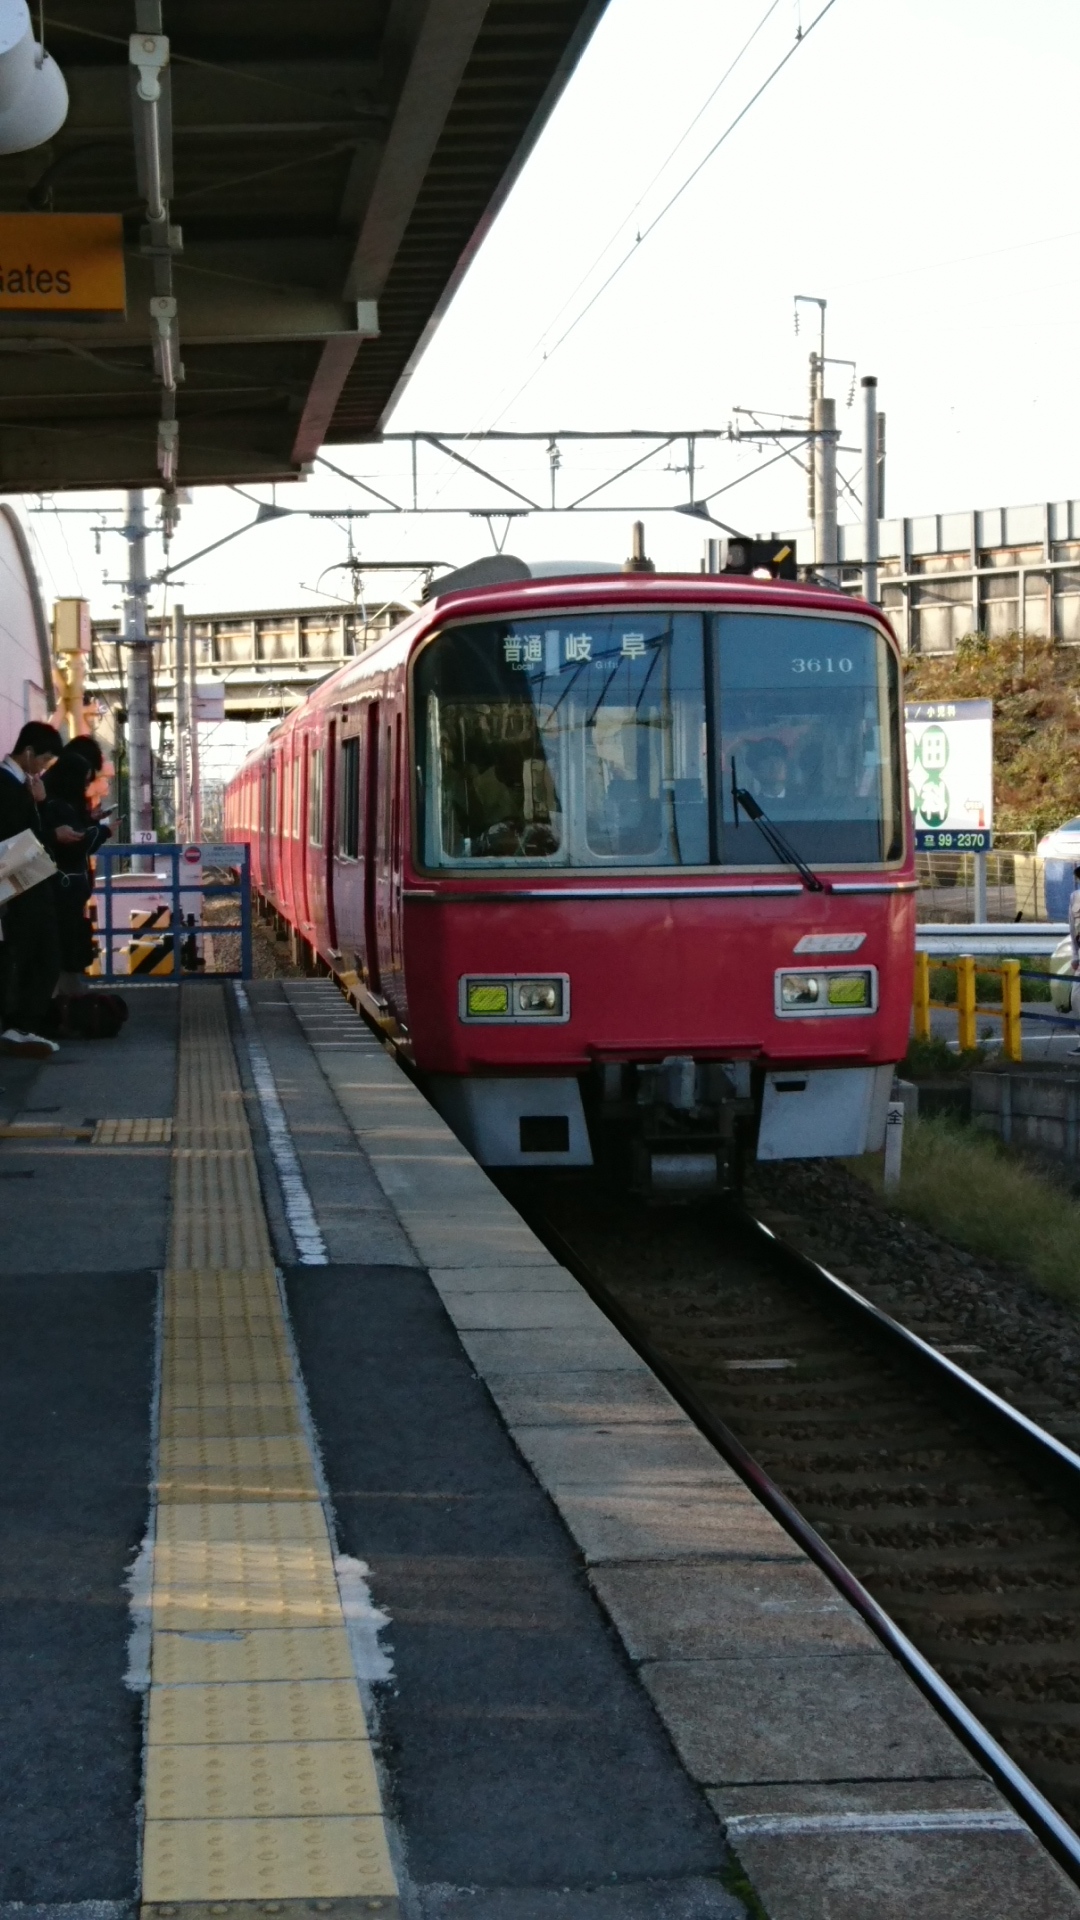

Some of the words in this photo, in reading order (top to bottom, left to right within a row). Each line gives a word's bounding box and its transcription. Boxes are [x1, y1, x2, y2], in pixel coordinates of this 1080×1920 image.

[0, 263, 71, 293] ates
[503, 634, 542, 662] 普通
[565, 632, 647, 661] 岐阜
[512, 663, 534, 671] Local
[791, 658, 853, 673] 3610
[140, 832, 152, 842] 70
